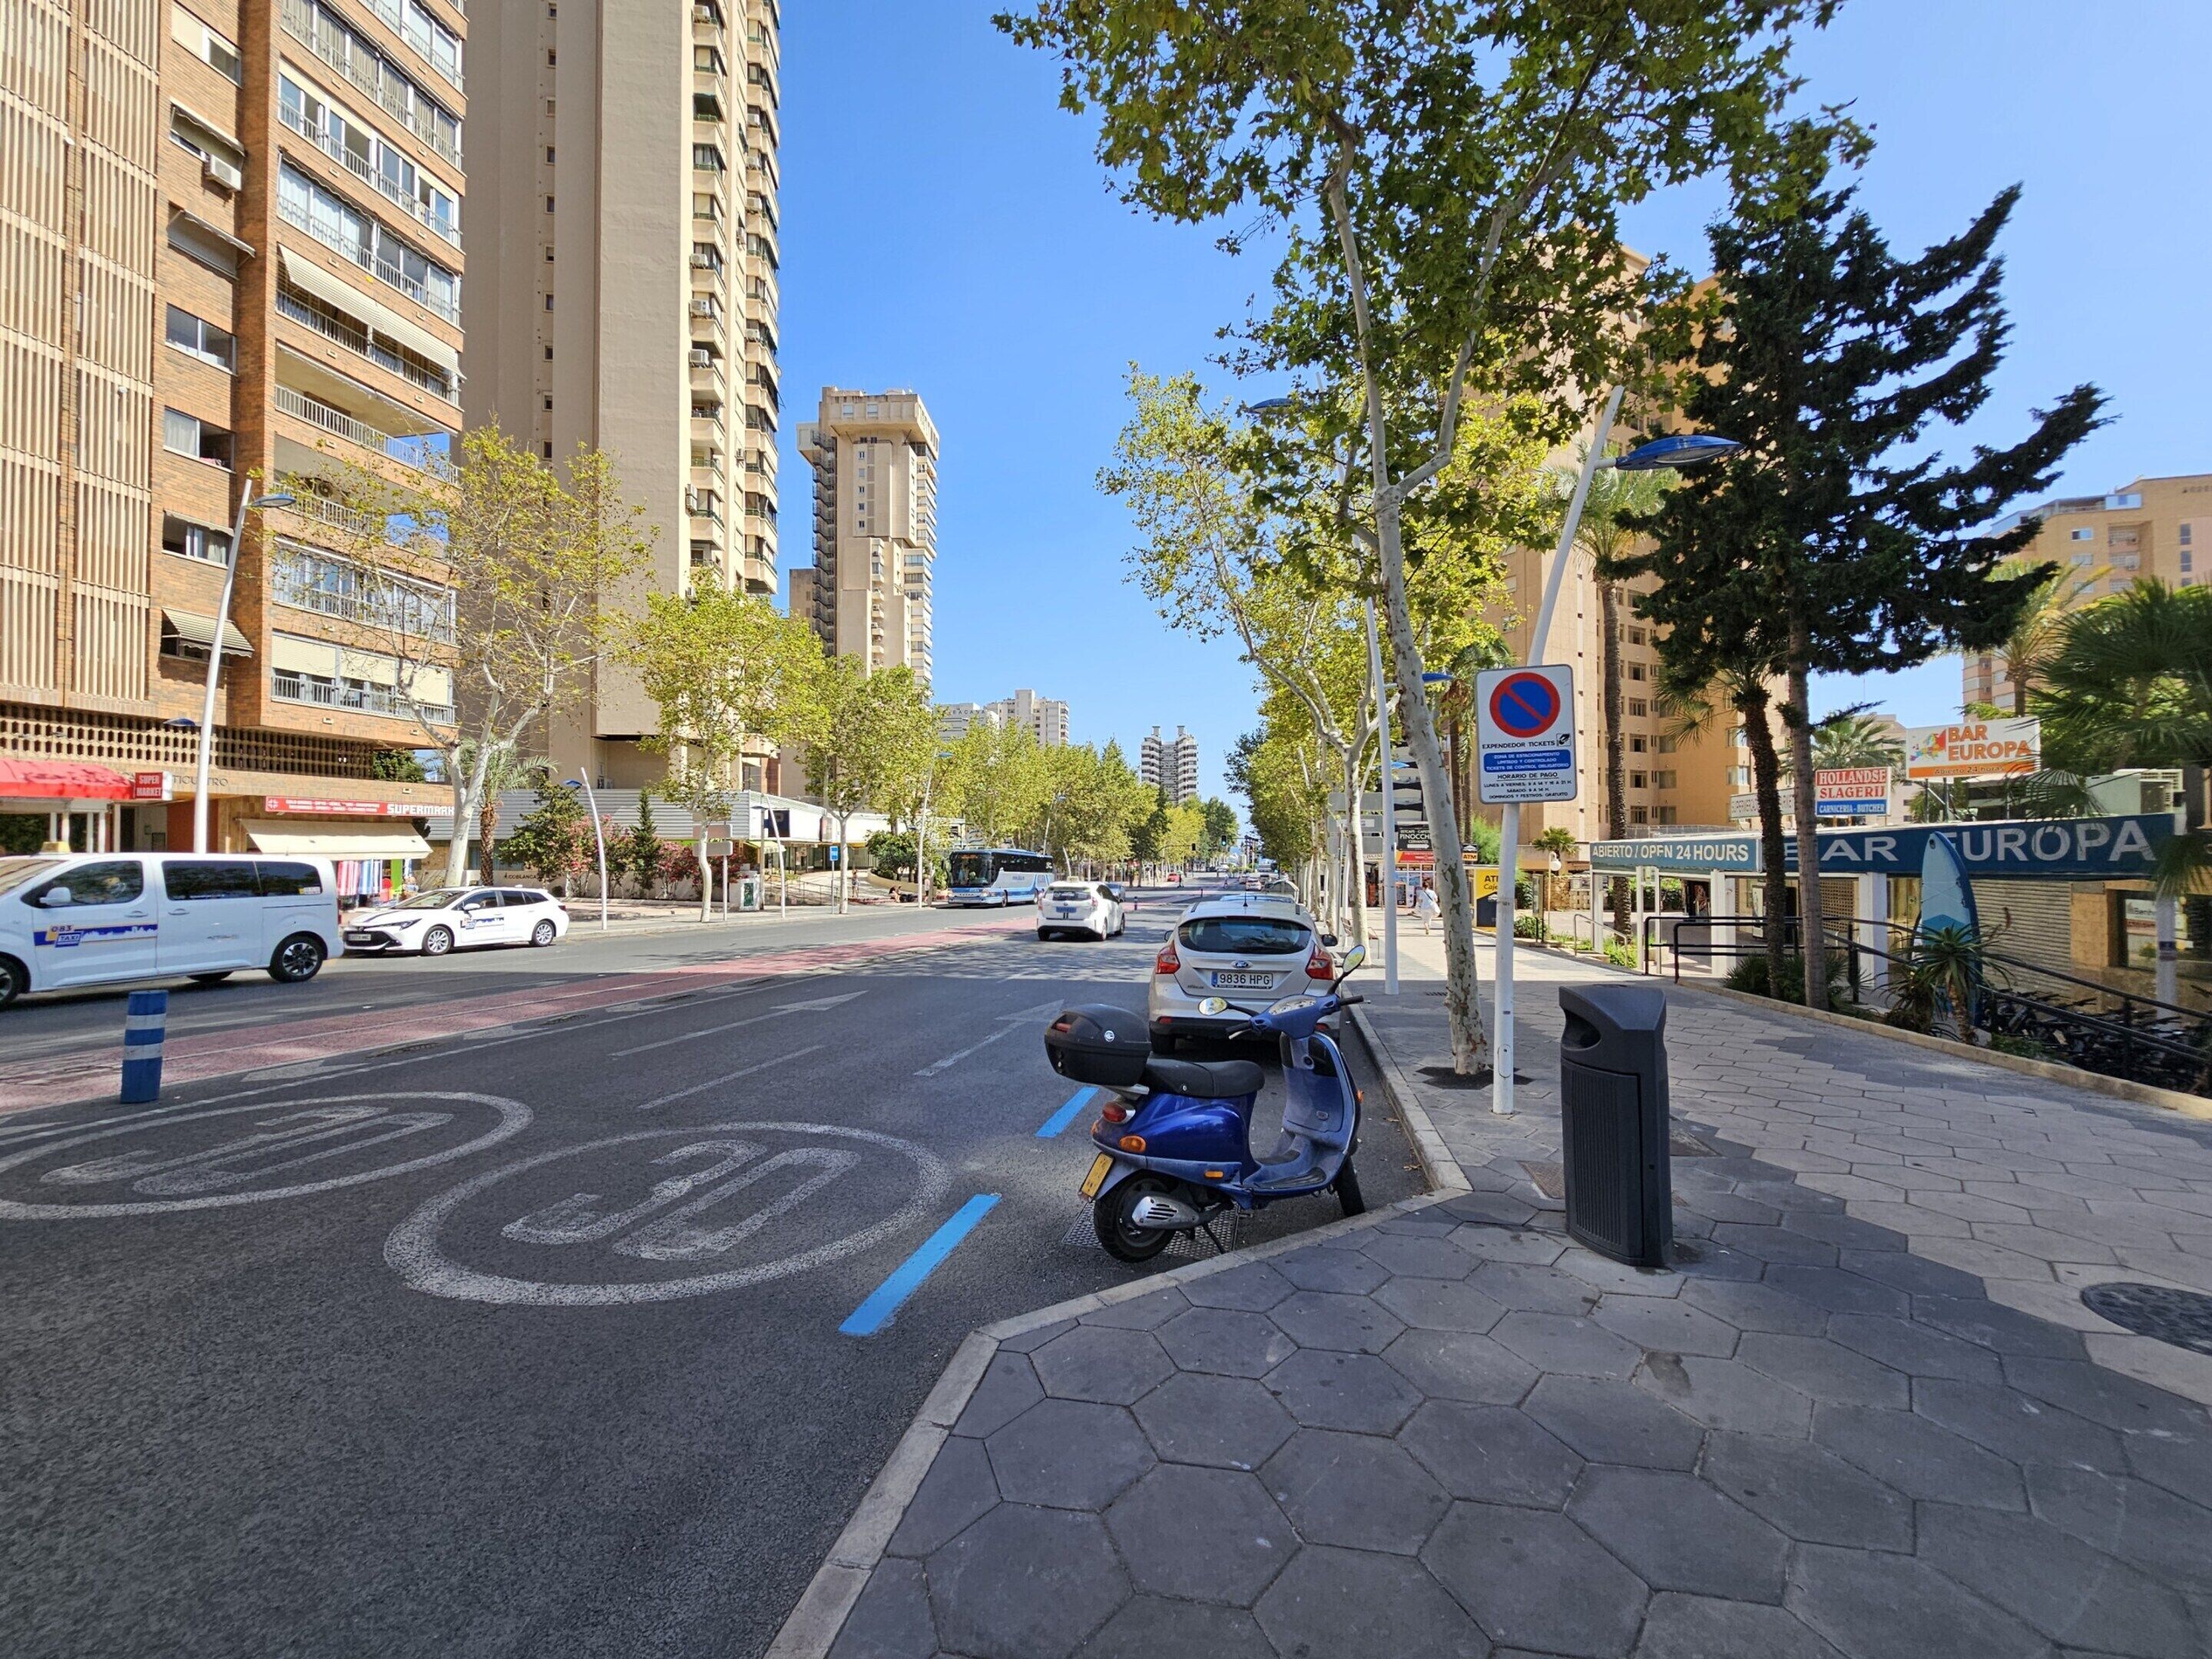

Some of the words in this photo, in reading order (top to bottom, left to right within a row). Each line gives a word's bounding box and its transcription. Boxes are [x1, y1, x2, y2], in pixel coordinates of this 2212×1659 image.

[1948, 724, 1988, 743] BAR
[1482, 741, 1526, 750] EXPENDEDOR
[1948, 740, 2032, 761] EUROPA
[139, 775, 160, 784] SUPER
[1819, 769, 1886, 785] HOLLANDSE
[136, 787, 163, 796] MARKET
[1820, 786, 1886, 799] SLAGERIJ
[386, 803, 455, 815] SUPERMARK
[1819, 804, 1853, 813] CARNICERIA
[1857, 803, 1885, 813] BUTCHER
[1592, 845, 1633, 859] ABIERTO
[1676, 845, 1691, 860] 24
[1693, 843, 1749, 862] HOURS
[1220, 973, 1246, 984] 9836
[1250, 975, 1270, 985] HPG
[502, 1138, 862, 1261] 30
